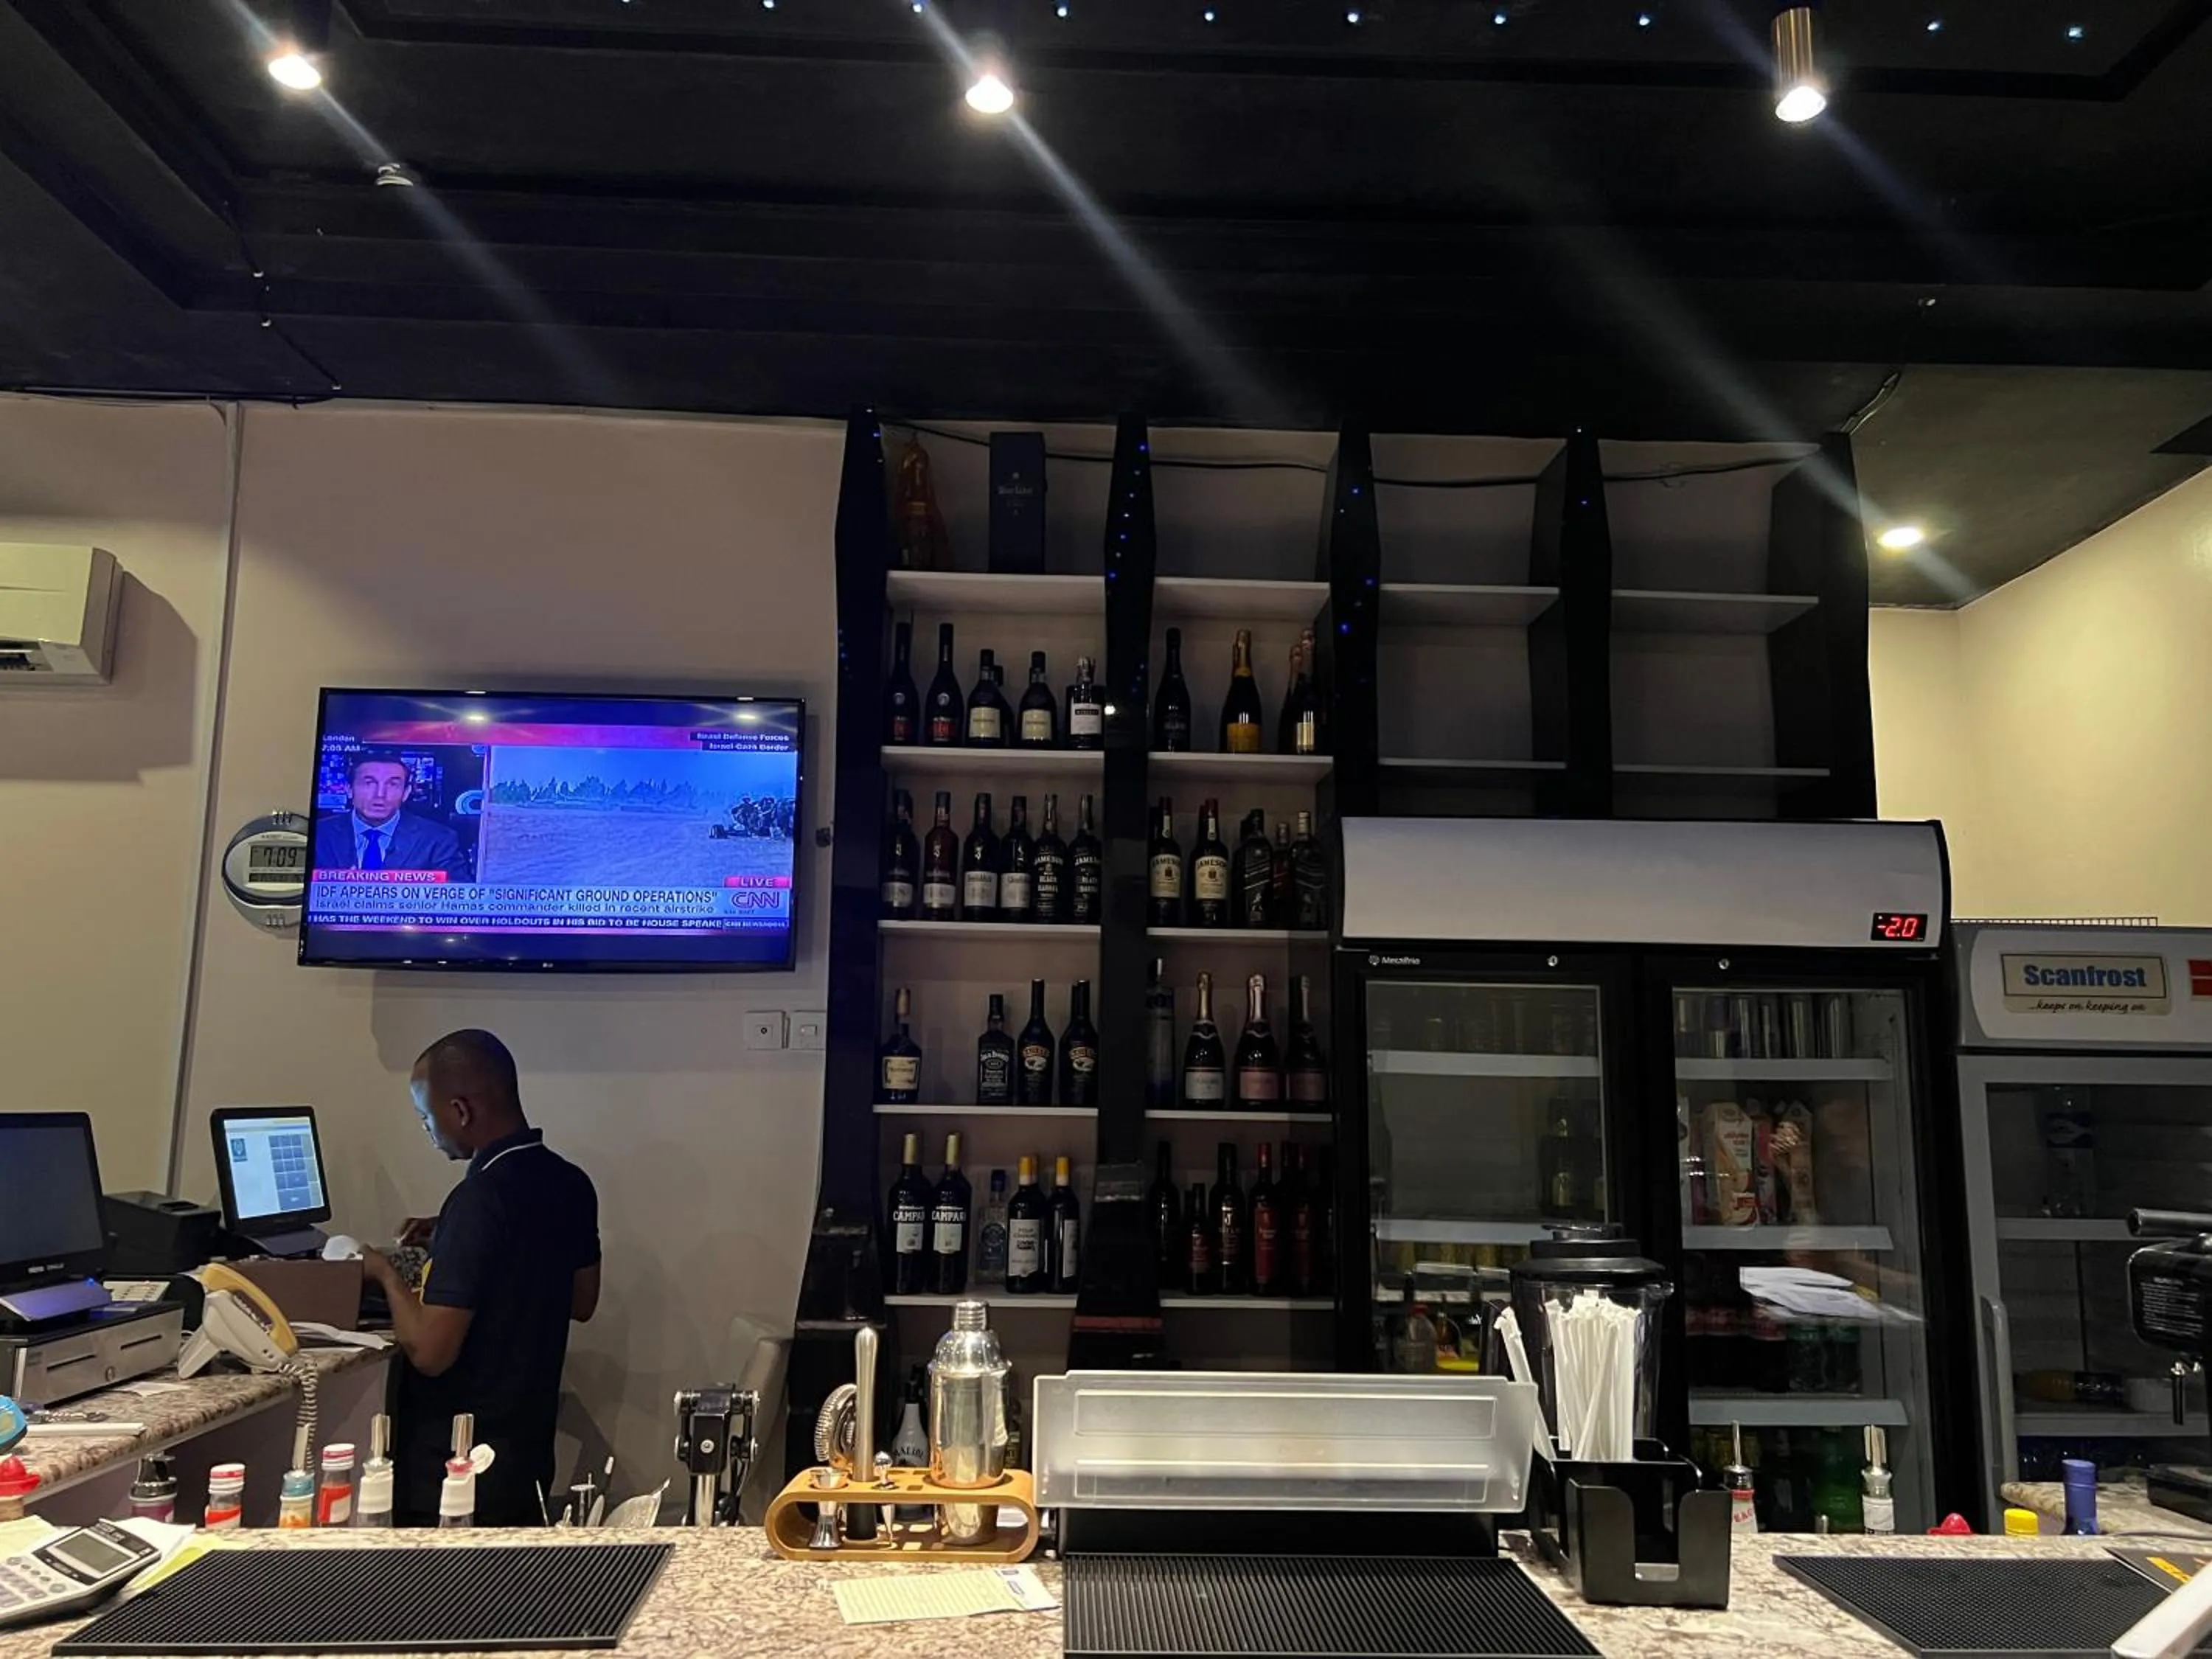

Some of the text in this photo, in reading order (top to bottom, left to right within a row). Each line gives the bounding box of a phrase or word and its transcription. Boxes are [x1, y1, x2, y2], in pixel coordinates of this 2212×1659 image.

[319, 871, 437, 882] BREAKING NEWS
[741, 877, 774, 887] LIVE
[317, 886, 717, 904] IDF APPEARS ON VERGE OF "SIGNIFICANT GROUND OPERATIONS"
[732, 891, 780, 908] CNN
[316, 899, 350, 909] Israel
[354, 900, 394, 910] claims
[399, 900, 437, 911] senior
[442, 901, 484, 911] Hamas
[487, 902, 564, 912] commander
[568, 903, 601, 912] killed
[605, 903, 616, 913] in
[619, 904, 660, 914] recent
[664, 905, 714, 914] airstrike
[338, 914, 361, 923] THE
[362, 915, 417, 925] WEEKEND
[419, 916, 434, 925] TO
[437, 916, 458, 925] WIN
[460, 917, 491, 925] OVER
[492, 917, 551, 926] HOLDOUTS
[552, 918, 565, 926] IN
[566, 918, 585, 927] HIS
[587, 919, 605, 927] BID
[608, 919, 623, 927] TO
[642, 919, 679, 928] HOUSE
[2023, 964, 2147, 987] Scanfrost
[2086, 1000, 2129, 1014] keeping
